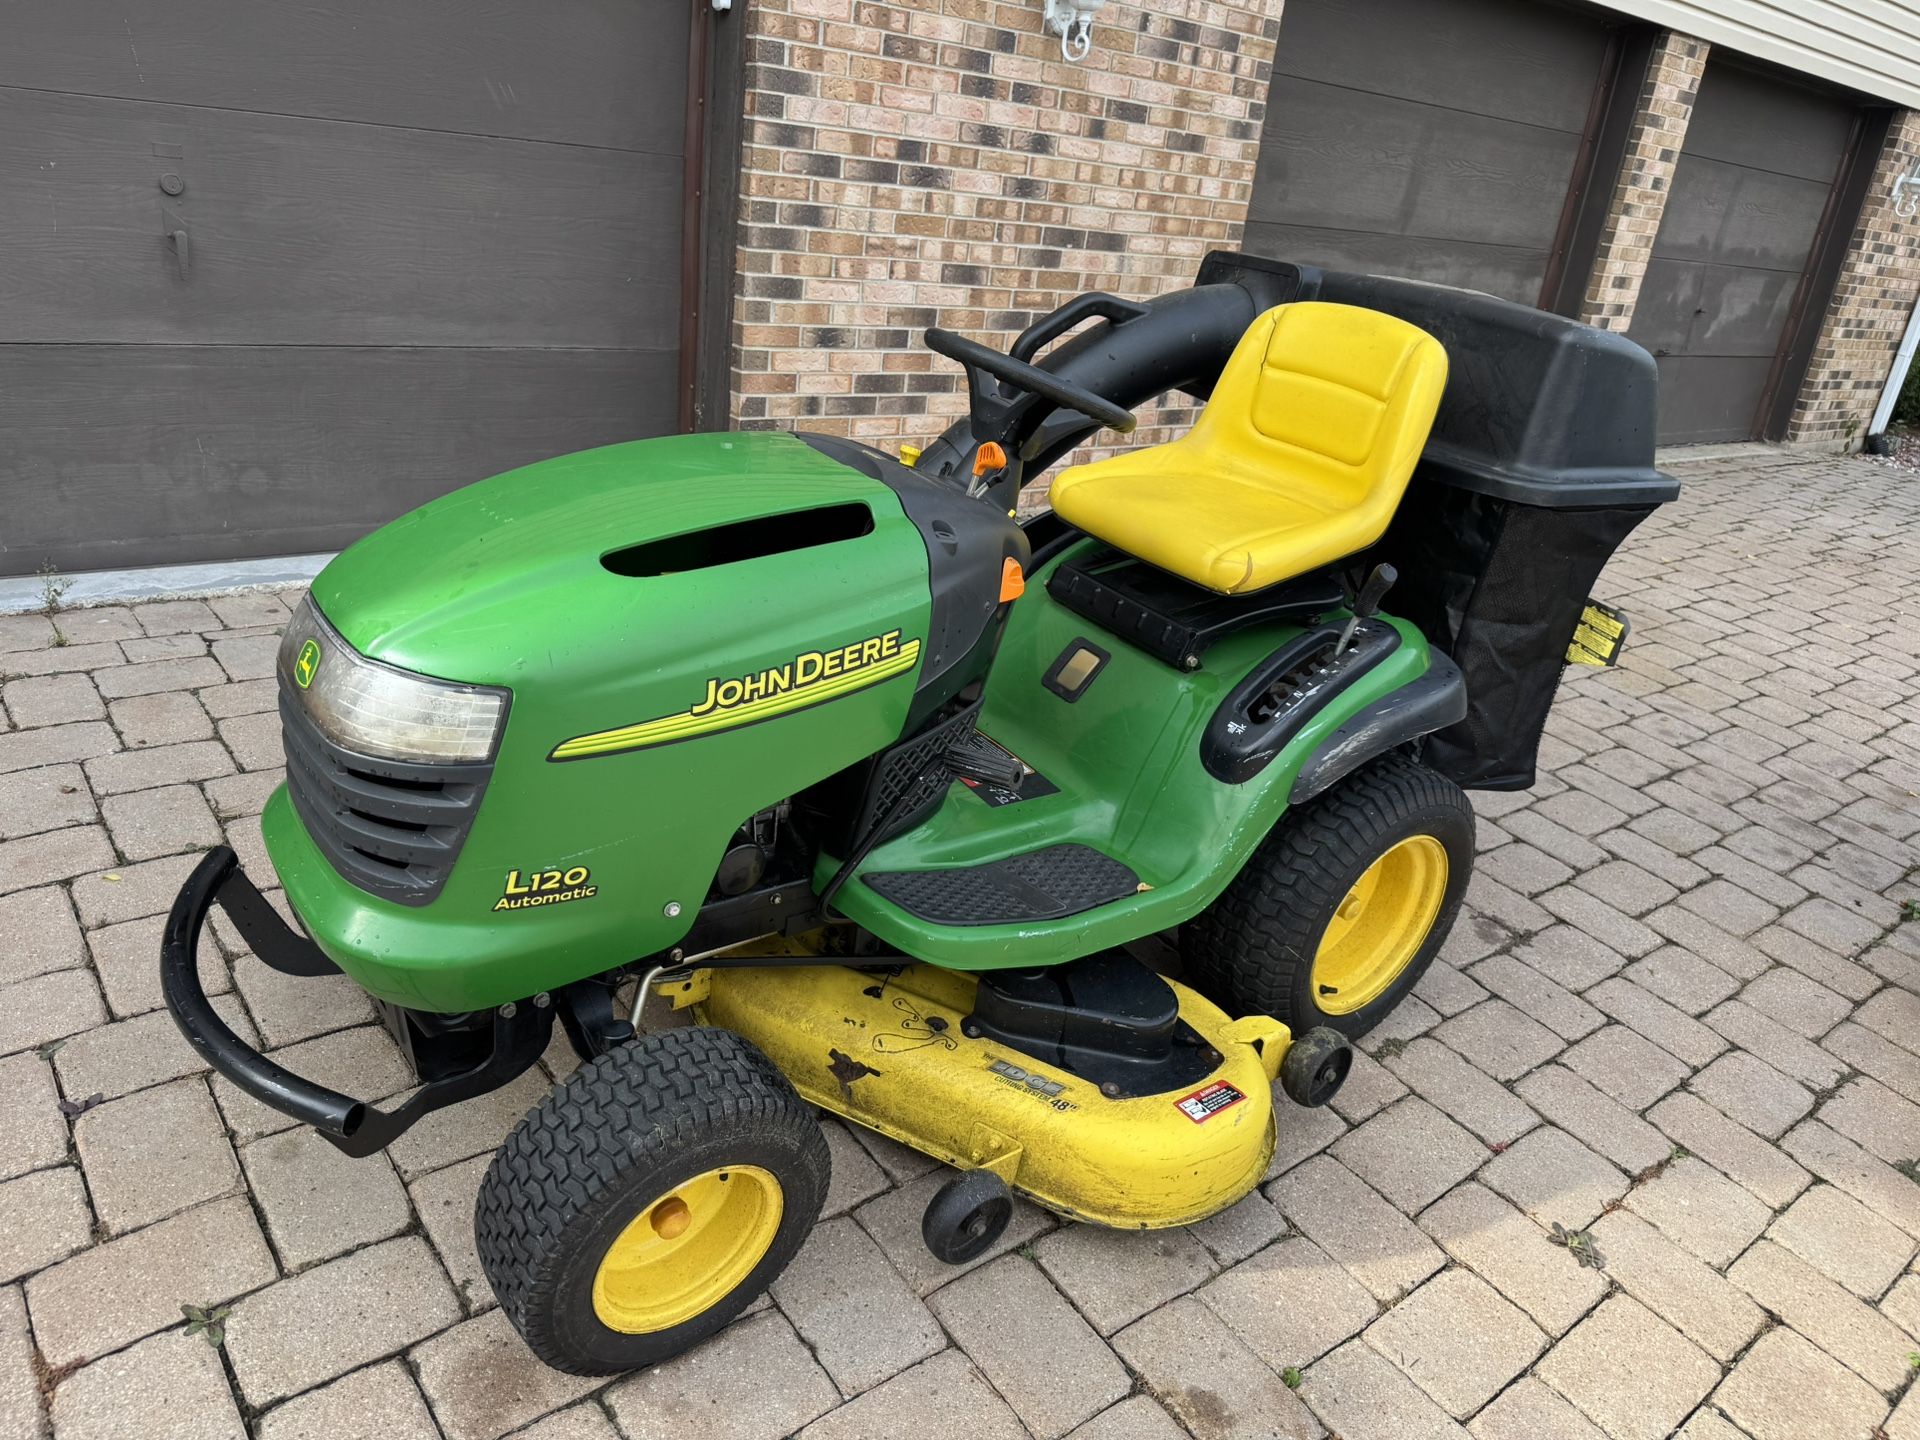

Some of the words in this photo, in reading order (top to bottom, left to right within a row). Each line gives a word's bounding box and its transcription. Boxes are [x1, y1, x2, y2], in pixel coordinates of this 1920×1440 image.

[691, 664, 792, 715] JOHN
[796, 630, 900, 683] DEERE
[505, 865, 589, 895] L120
[494, 886, 597, 909] Automatic
[987, 1059, 1066, 1097] EDGE
[994, 1075, 1024, 1091] CUTTING
[1022, 1084, 1052, 1102] SYSTEM
